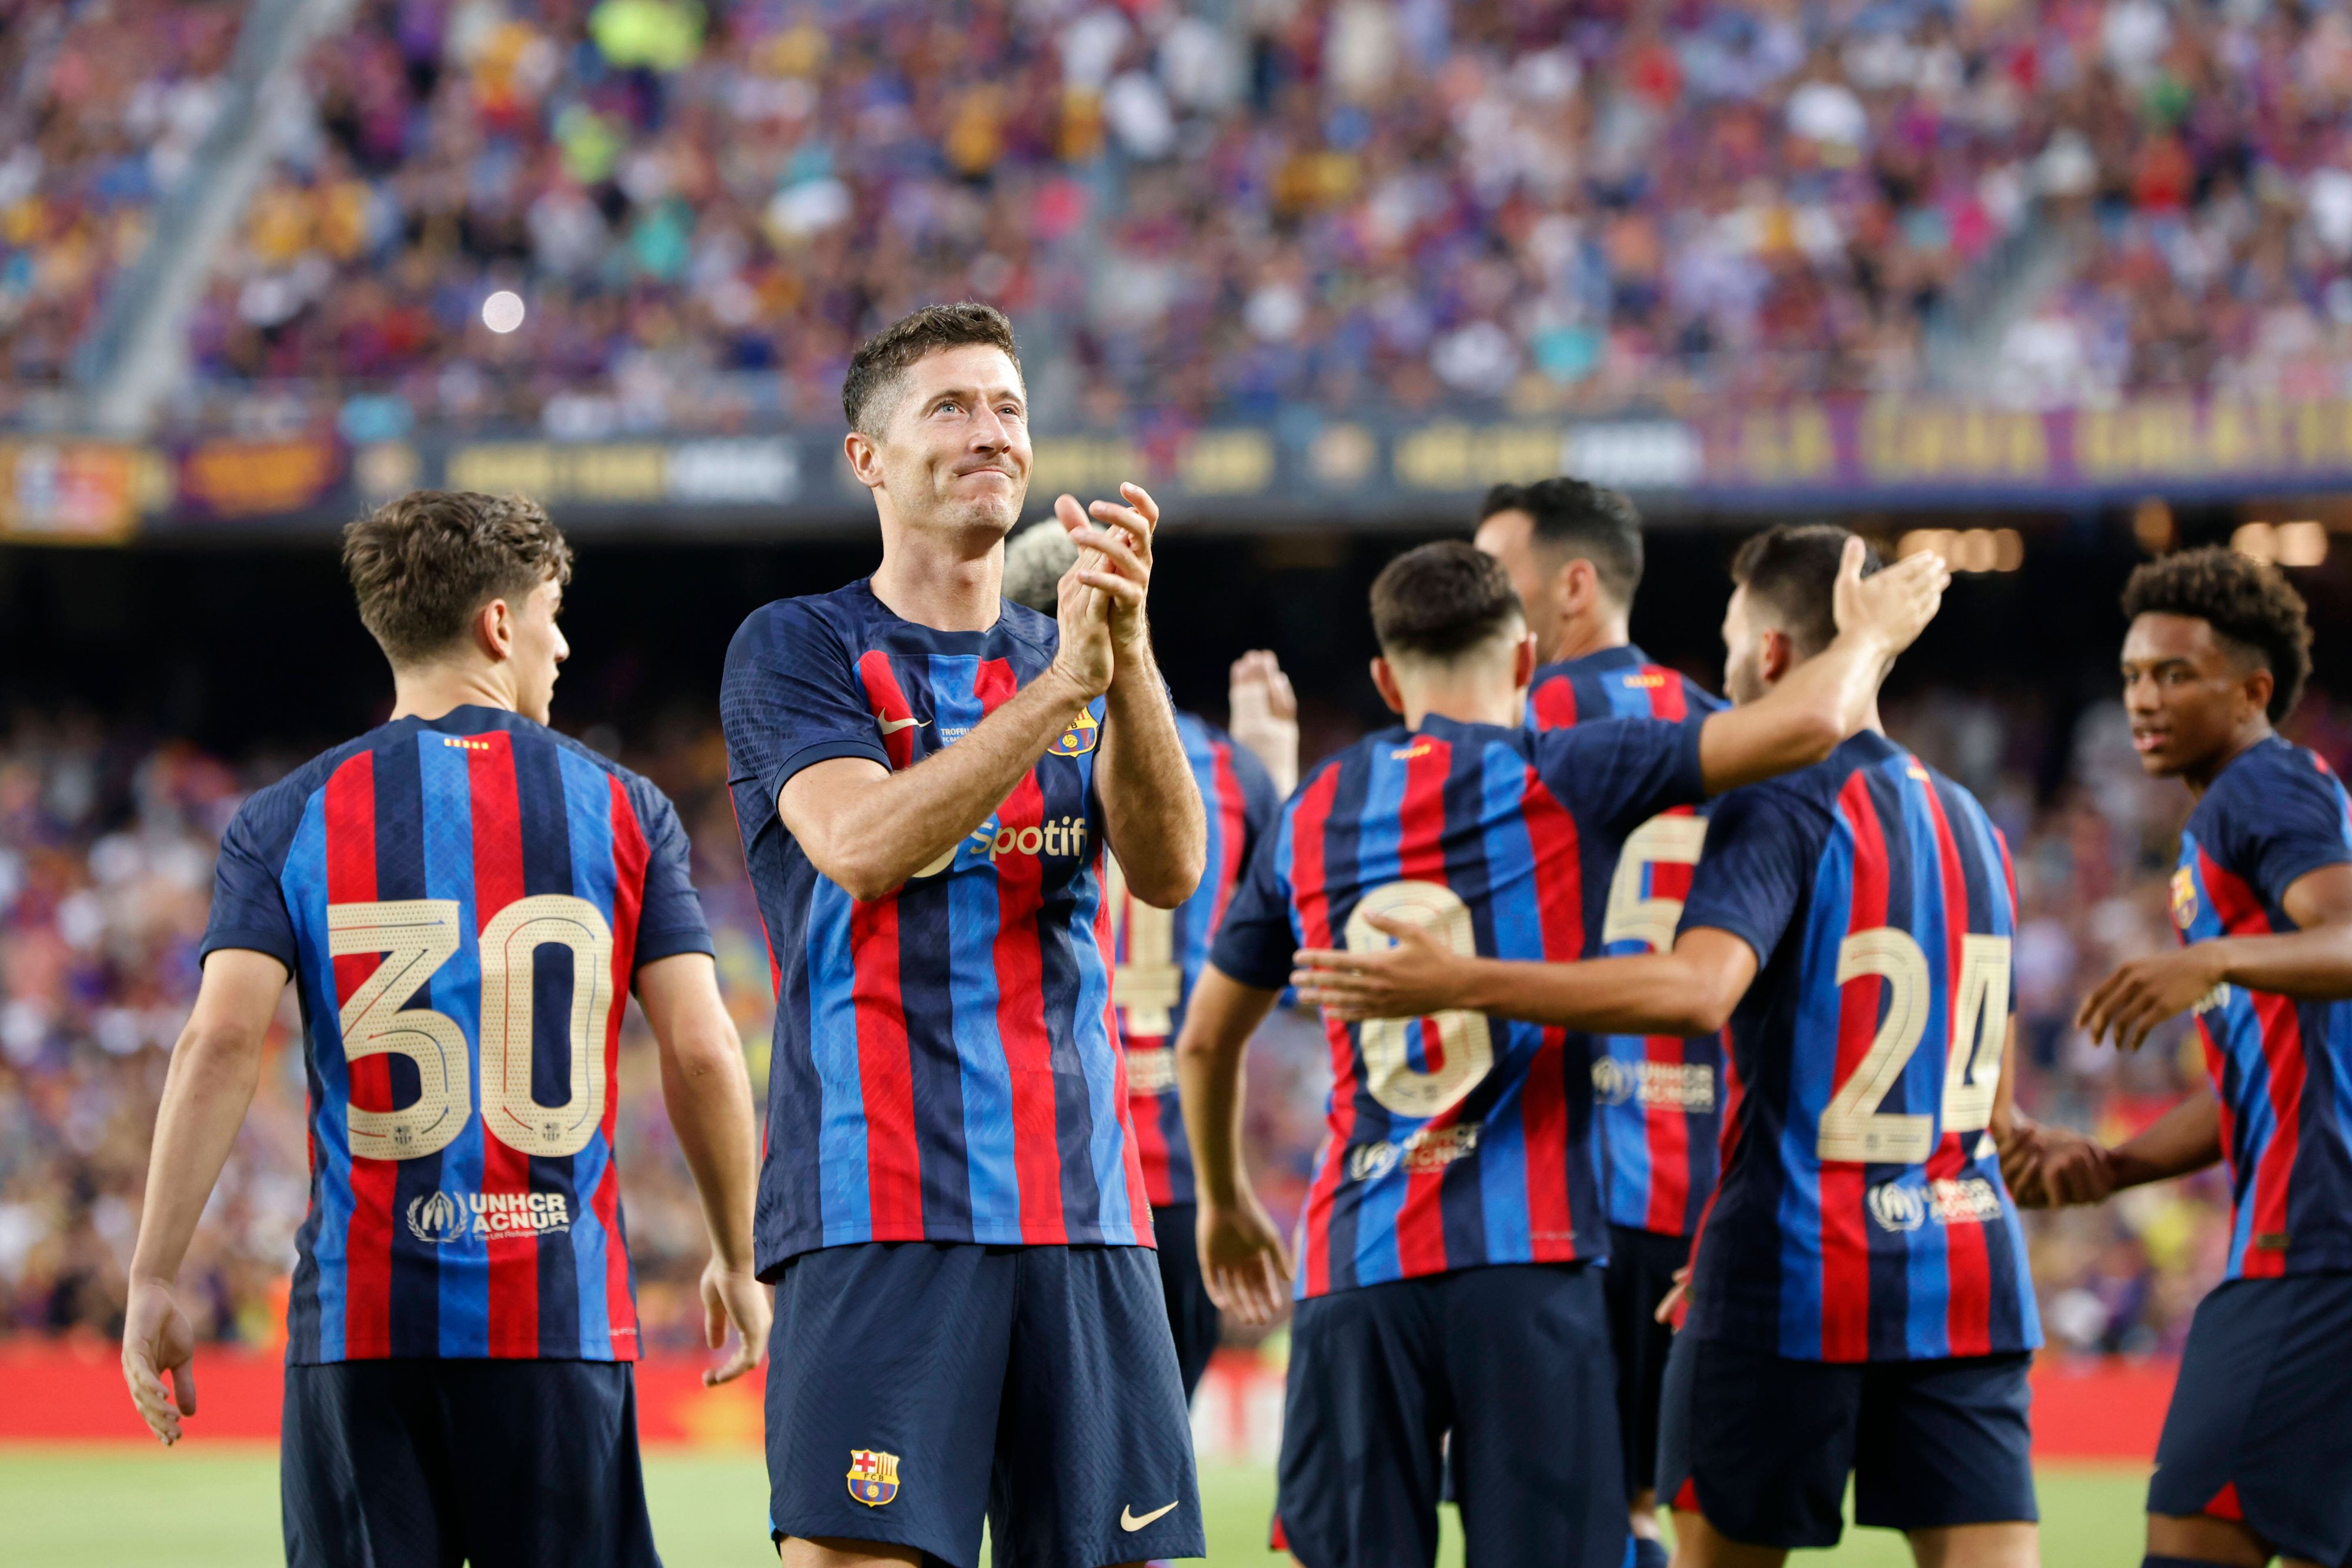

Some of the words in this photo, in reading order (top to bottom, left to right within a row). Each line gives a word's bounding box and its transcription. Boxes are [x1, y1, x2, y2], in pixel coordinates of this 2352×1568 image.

[327, 894, 614, 1160] 30
[1816, 927, 2012, 1164] 24
[469, 1192, 567, 1214] UNHCR
[472, 1211, 569, 1233] ACNUR
